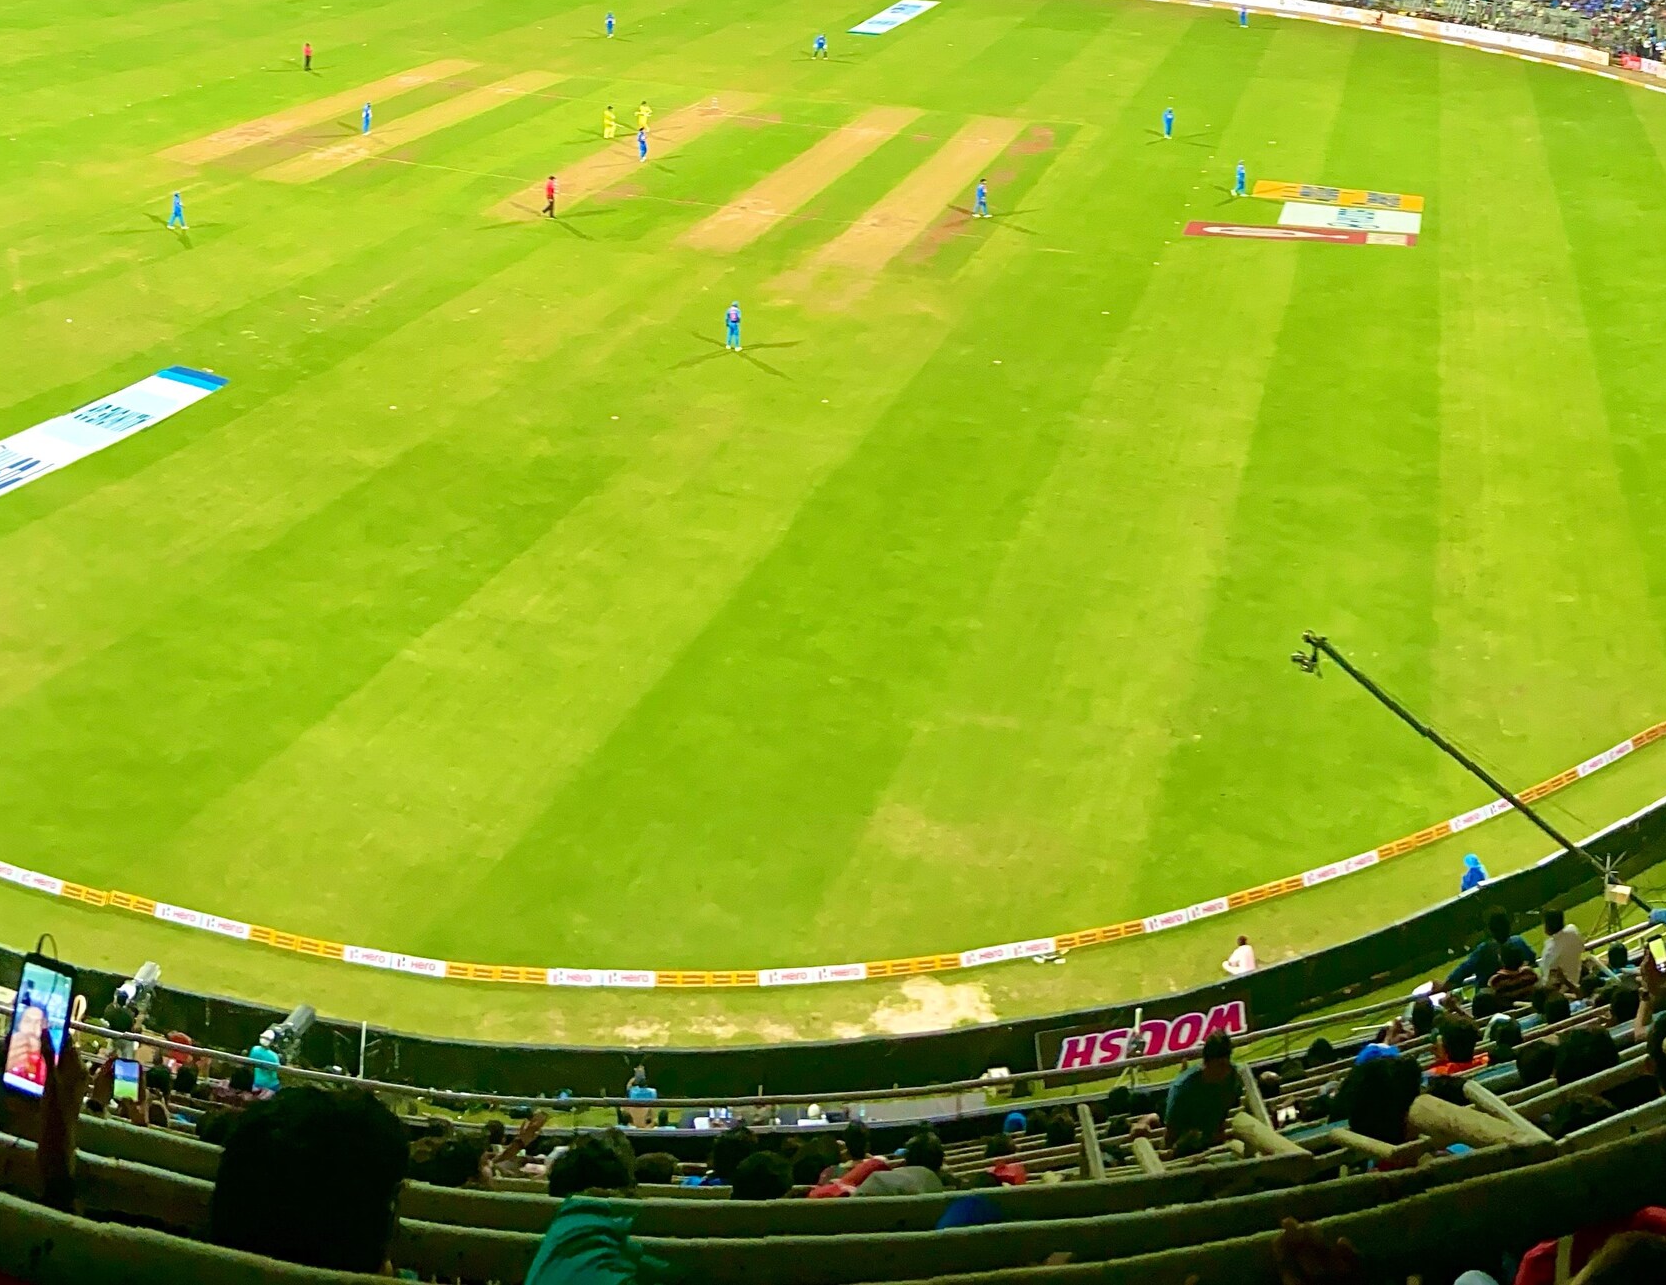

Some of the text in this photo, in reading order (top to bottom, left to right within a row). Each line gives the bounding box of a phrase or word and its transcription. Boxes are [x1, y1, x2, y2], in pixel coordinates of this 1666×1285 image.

[1352, 853, 1375, 866] Hero
[1316, 867, 1339, 880] Hero
[33, 877, 57, 890] Hero
[1201, 901, 1225, 915] Hero
[173, 909, 197, 922] Hero
[1160, 913, 1184, 927] Hero
[218, 921, 244, 935] Hero
[978, 947, 1004, 961] Hero
[1024, 942, 1049, 955] Hero
[361, 951, 385, 964] Hero
[410, 959, 436, 972] Hero
[566, 973, 592, 983] Hero
[620, 973, 649, 983] Hero
[781, 972, 808, 982] Hero
[831, 967, 860, 978] Hero
